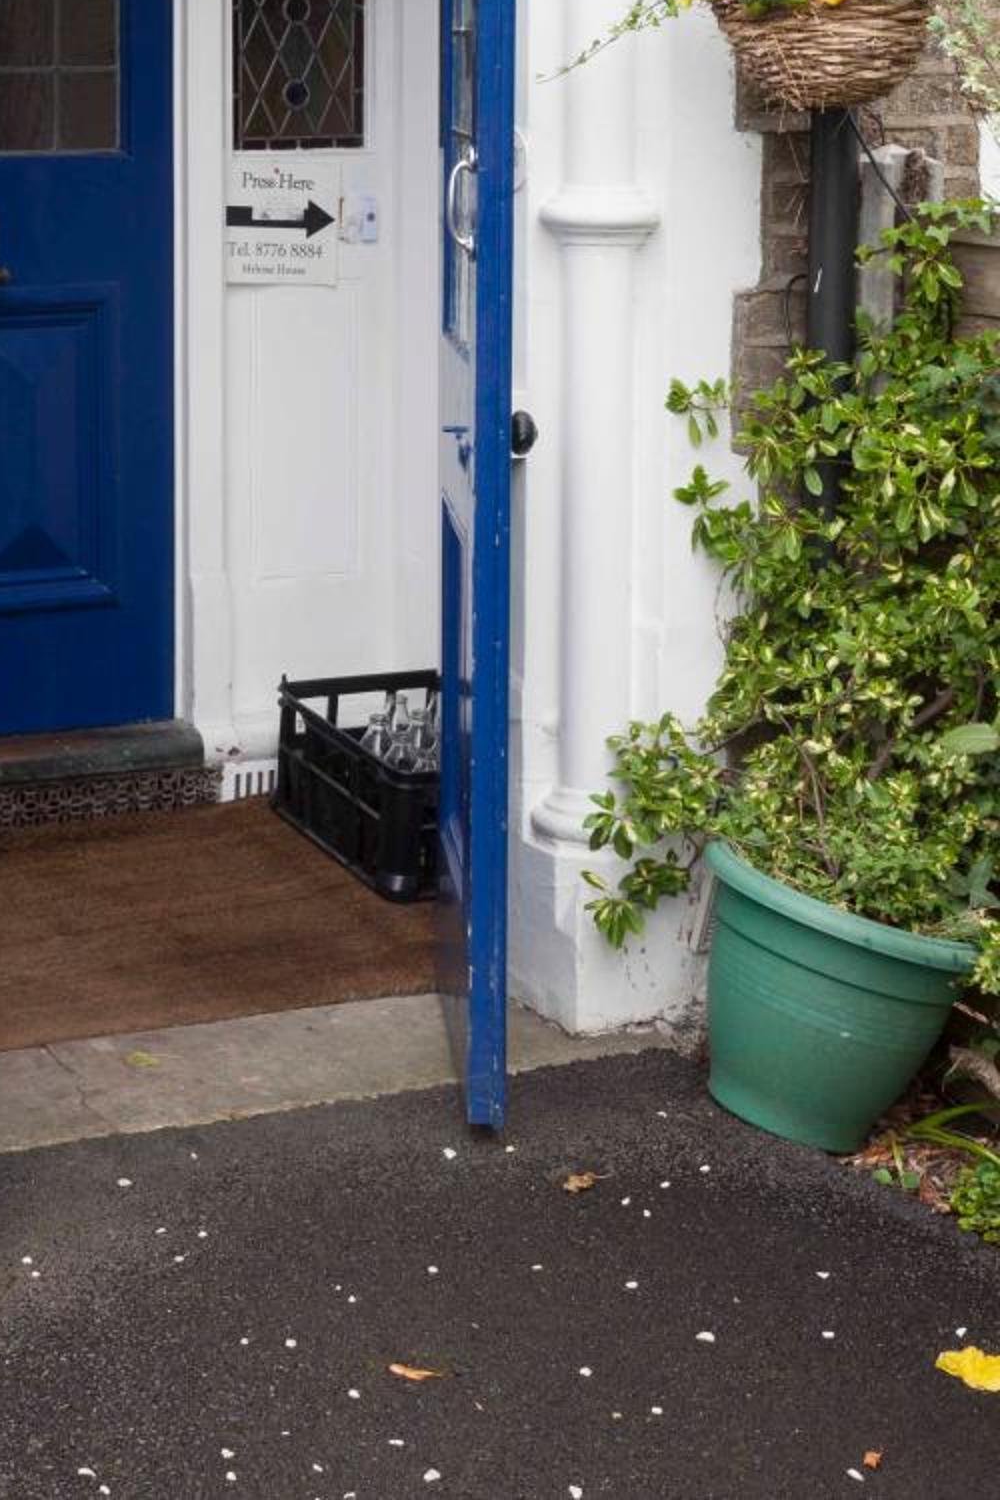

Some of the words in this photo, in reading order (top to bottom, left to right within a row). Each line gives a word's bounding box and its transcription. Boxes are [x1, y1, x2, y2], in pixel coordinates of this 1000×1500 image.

[242, 171, 278, 189] Press
[279, 173, 315, 191] Here
[255, 242, 287, 258] 8776
[290, 243, 323, 259] 8884
